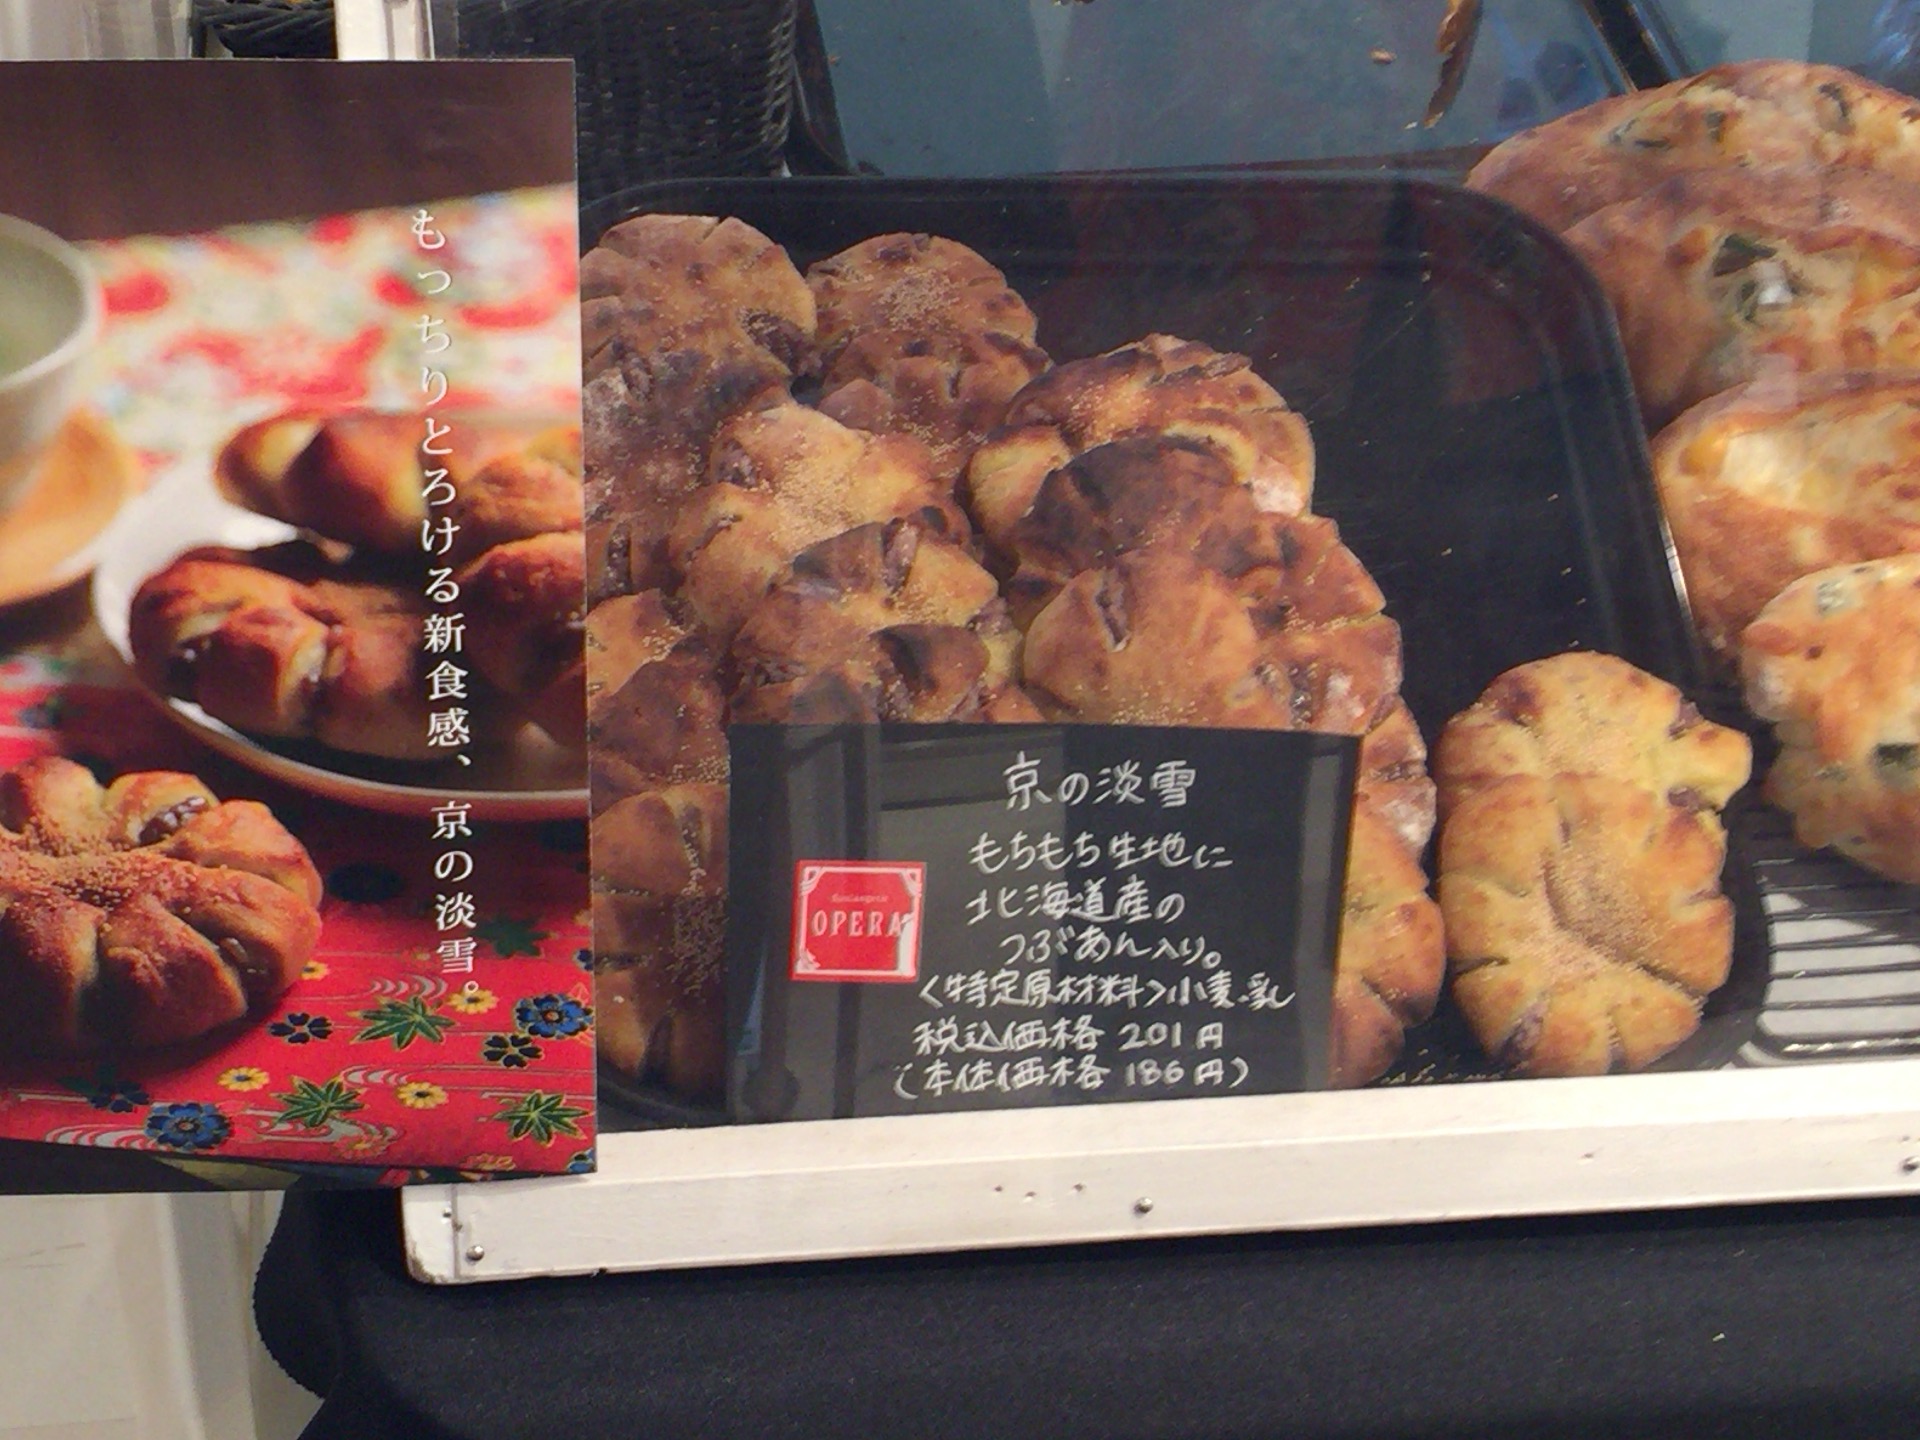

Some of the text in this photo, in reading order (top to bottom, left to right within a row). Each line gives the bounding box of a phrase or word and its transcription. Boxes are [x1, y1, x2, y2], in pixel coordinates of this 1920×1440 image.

[1003, 751, 1196, 811] 京の淡雪
[968, 830, 1233, 875] もちもち生地に
[966, 873, 1185, 926] 北海道産の
[811, 909, 902, 937] OPERA
[1000, 924, 1222, 969] つぶあん入り。
[912, 1014, 1104, 1055] 税込価格
